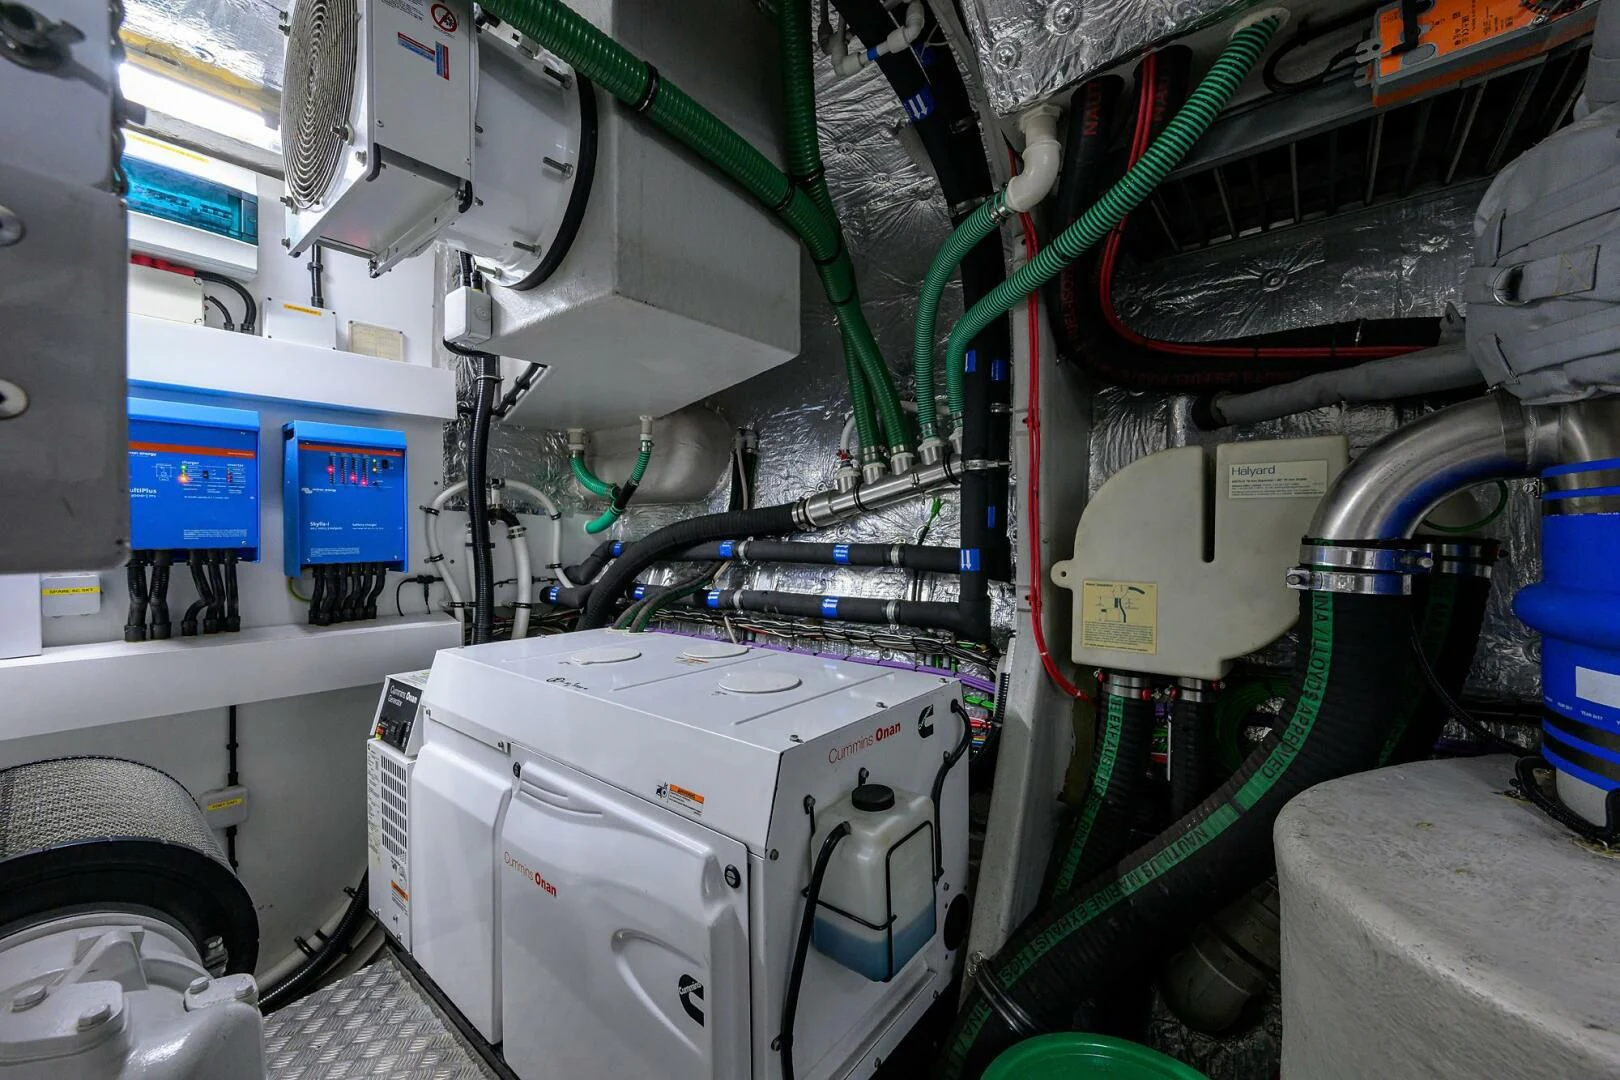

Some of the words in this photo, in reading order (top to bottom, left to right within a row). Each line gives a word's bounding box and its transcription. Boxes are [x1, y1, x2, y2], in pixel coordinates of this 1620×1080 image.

[1231, 465, 1276, 477] Halyard
[1314, 595, 1329, 622] INA
[1304, 638, 1329, 702] LLOYDS
[828, 735, 873, 764] Cummins
[875, 722, 900, 741] Onan
[1262, 703, 1313, 779] APPROVED
[504, 851, 534, 880] Cummins
[535, 872, 557, 897] Onan
[1138, 827, 1207, 878] NAUTILUS
[1087, 872, 1140, 911] MARINE
[1031, 905, 1088, 951] EXHAUST
[999, 950, 1031, 983] HOS
